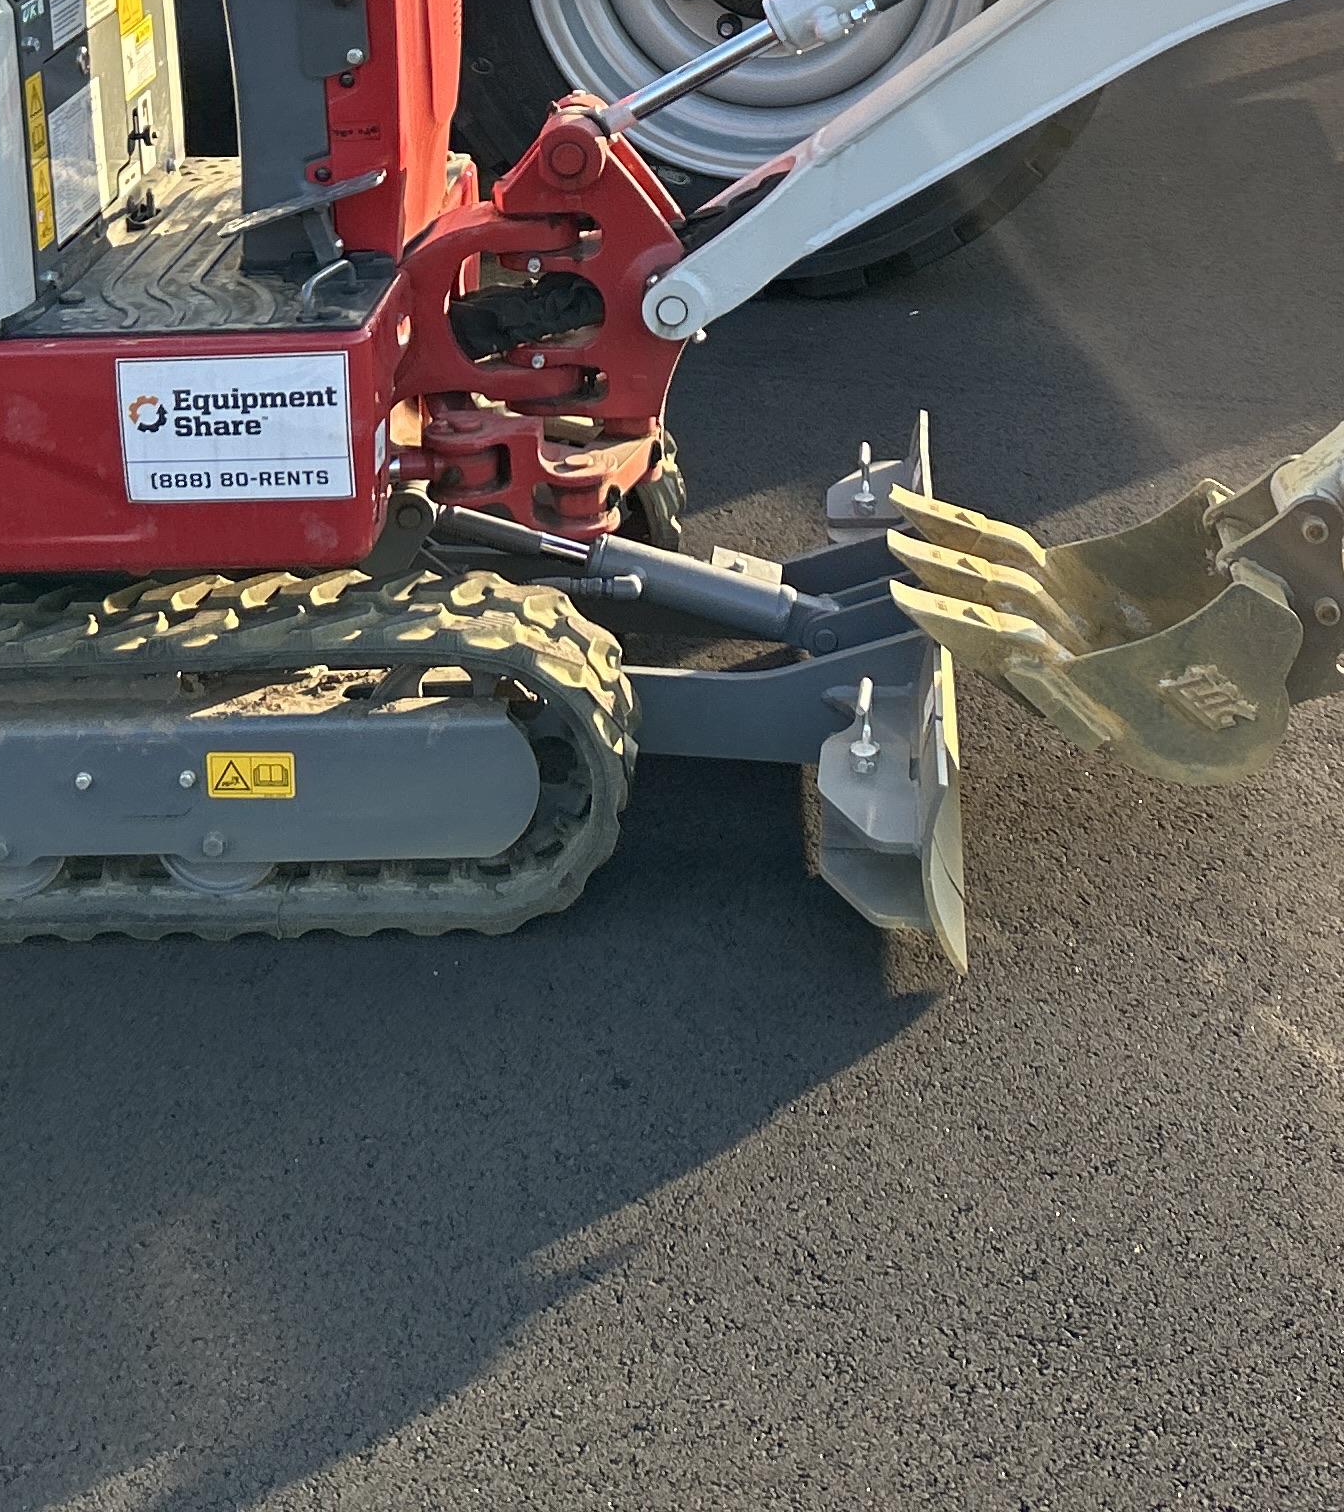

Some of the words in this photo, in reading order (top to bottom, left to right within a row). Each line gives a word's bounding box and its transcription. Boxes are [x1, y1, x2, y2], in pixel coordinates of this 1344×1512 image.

[172, 386, 338, 416] Equipment
[174, 416, 262, 437] Share
[150, 471, 212, 490] (888)
[220, 470, 330, 487] 80-RENTS
